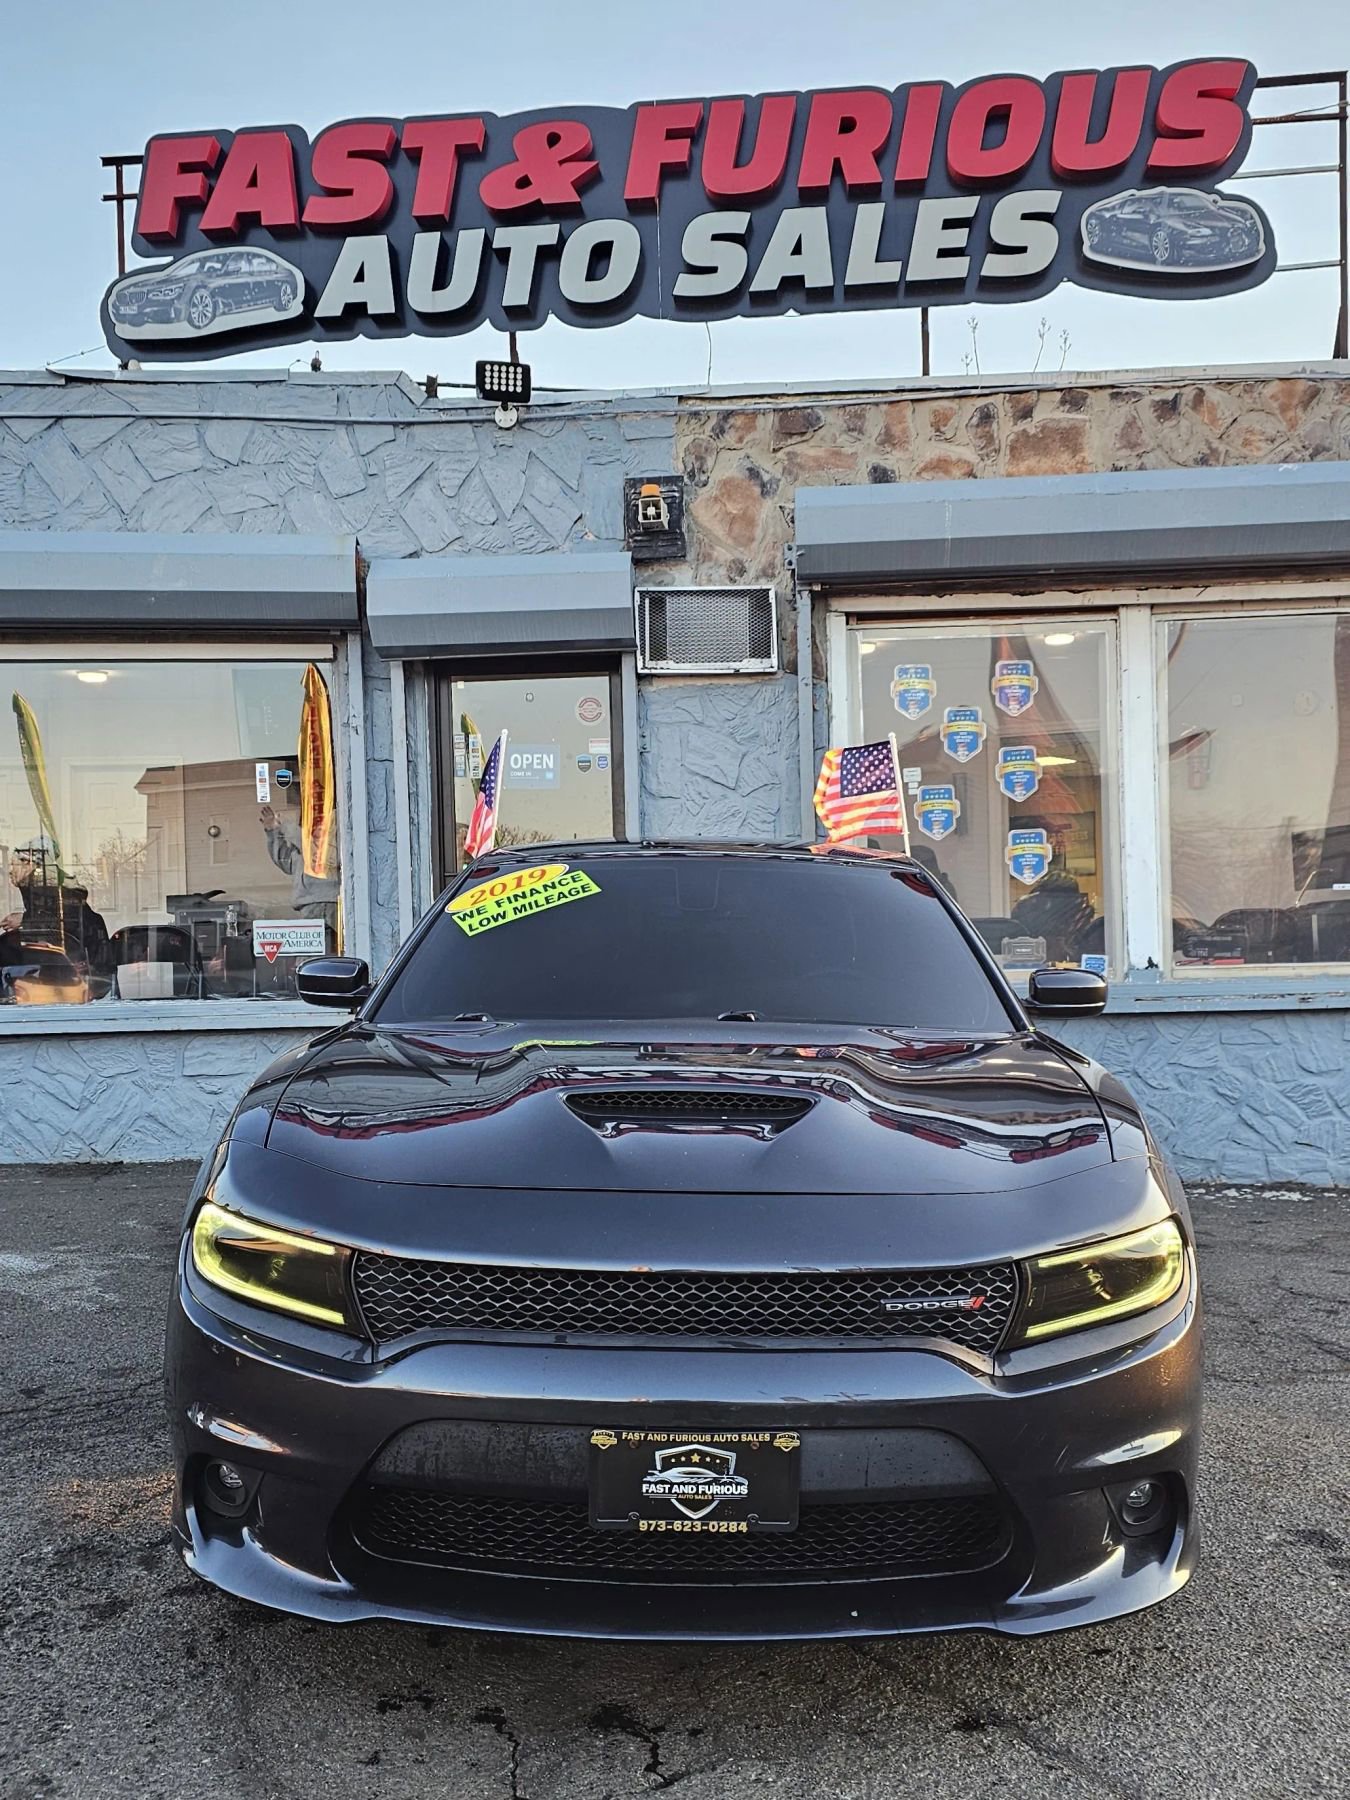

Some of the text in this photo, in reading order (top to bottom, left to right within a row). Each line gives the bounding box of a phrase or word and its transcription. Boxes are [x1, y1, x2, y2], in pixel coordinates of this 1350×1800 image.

[137, 117, 486, 240] FAST
[623, 61, 1251, 208] FURIOUS
[313, 189, 1063, 320] AUTO SALES
[510, 753, 554, 769] OPEN
[470, 868, 548, 906] 2019
[457, 873, 585, 922] WE FINANCE
[468, 883, 593, 932] LOW MILEAGE
[256, 930, 323, 940] MOTOR CLUB OF
[264, 944, 278, 952] MCA
[283, 939, 323, 948] AMERICA
[885, 1298, 974, 1312] DODGE
[622, 1431, 646, 1442] FAST
[647, 1432, 668, 1442] AND
[669, 1433, 712, 1443] FURIOUS
[713, 1433, 739, 1442] AUTO
[740, 1433, 771, 1442] SALES
[642, 1483, 749, 1495] FAST AND FURIOUS
[638, 1520, 749, 1533] 973-623-0284
